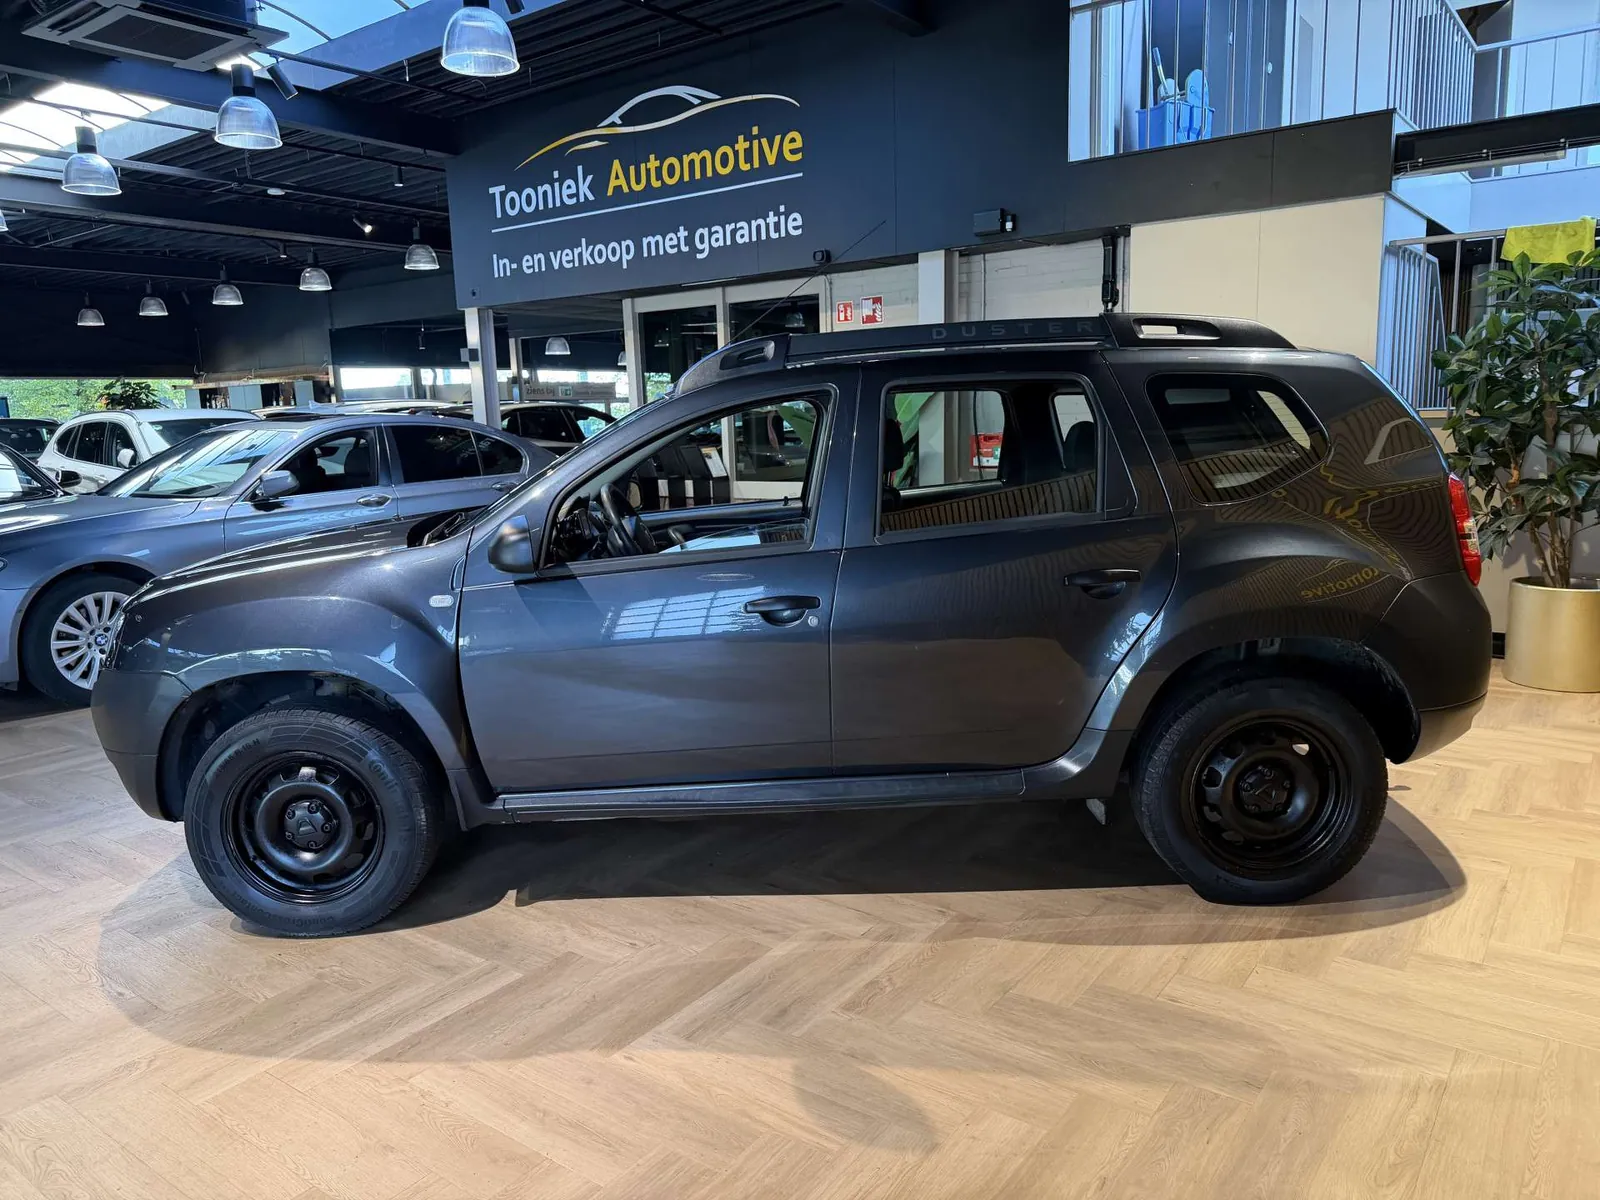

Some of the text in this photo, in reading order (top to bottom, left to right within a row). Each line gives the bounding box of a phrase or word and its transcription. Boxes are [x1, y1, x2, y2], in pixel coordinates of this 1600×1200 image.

[489, 125, 803, 219] Tooniek Automotive
[492, 204, 803, 278] In- en verkoop met garantie
[932, 321, 1093, 340] DUSTER
